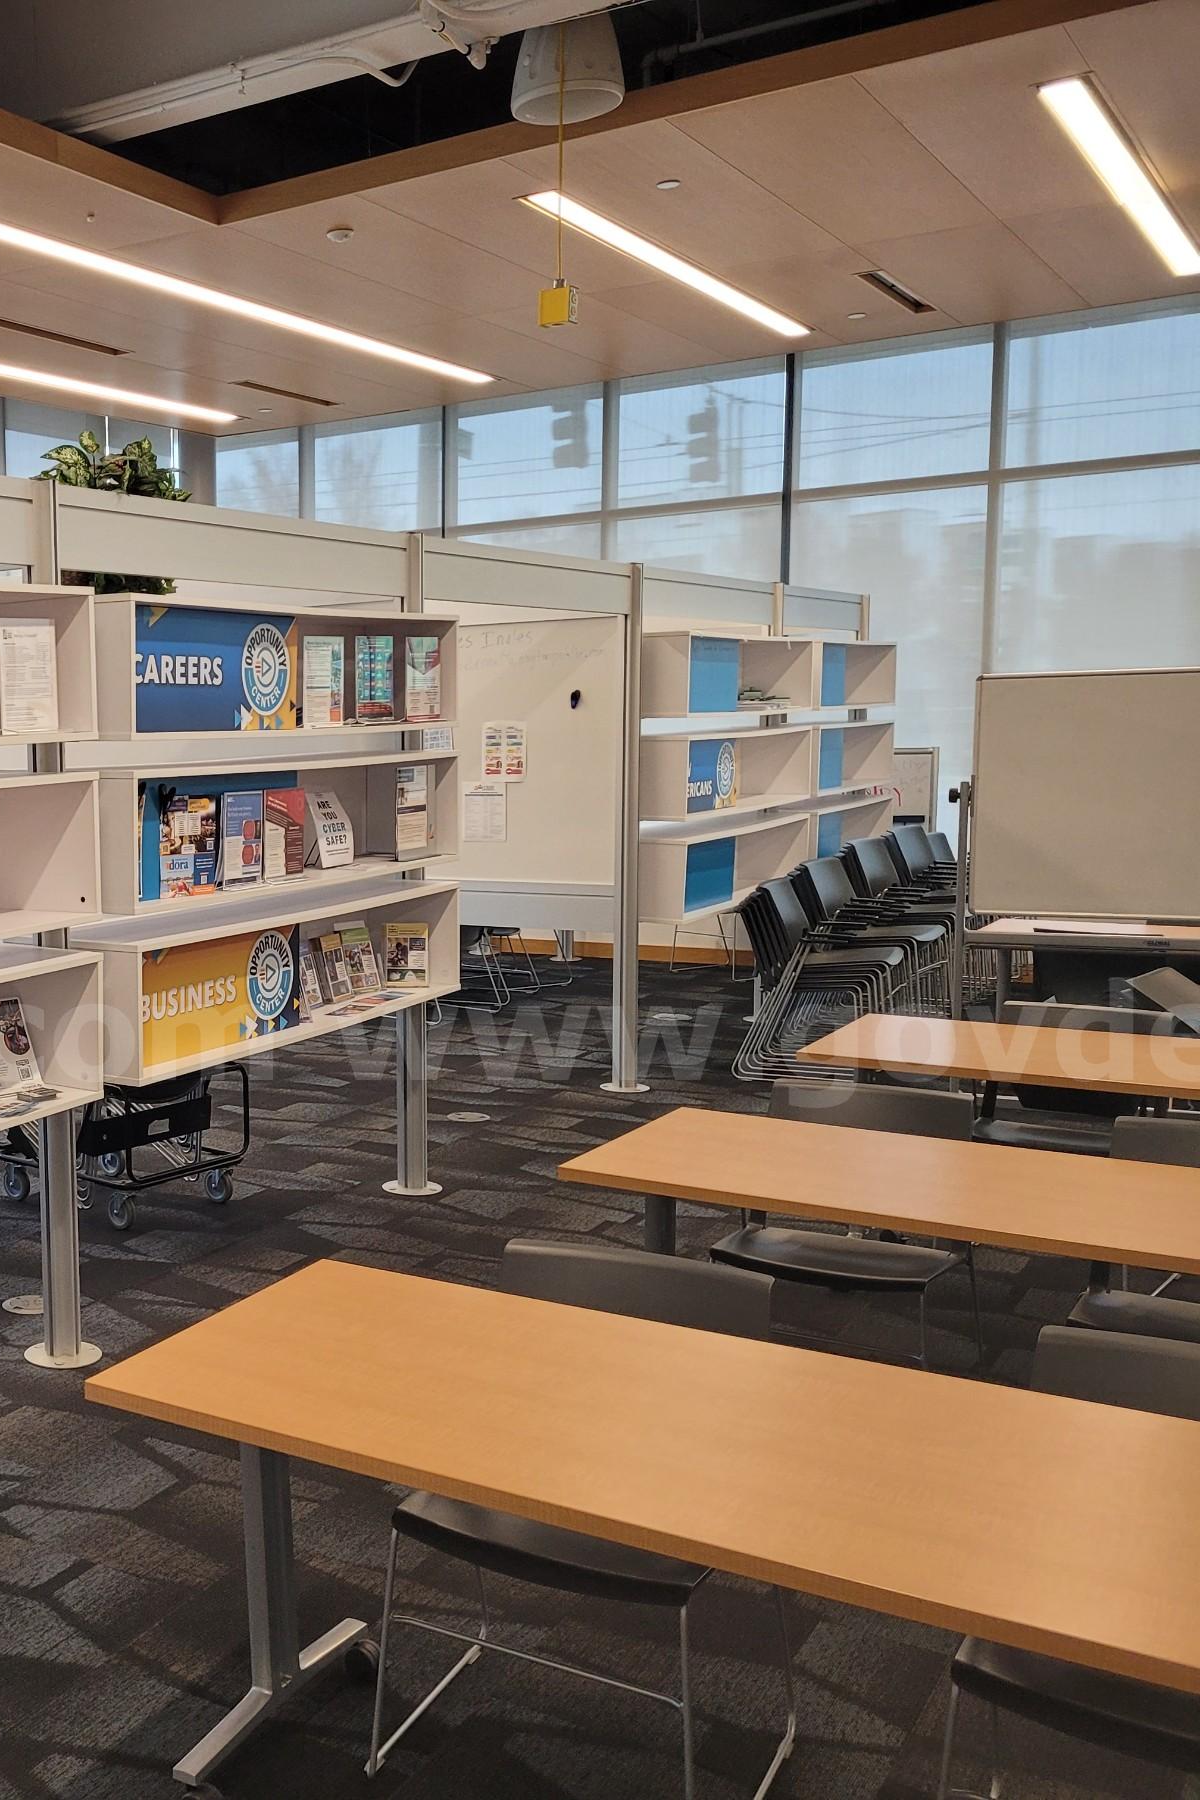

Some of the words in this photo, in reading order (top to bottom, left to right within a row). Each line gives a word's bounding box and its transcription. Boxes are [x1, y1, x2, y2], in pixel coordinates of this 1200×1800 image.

[244, 628, 287, 668] OPPORTUNITY
[135, 653, 224, 686] CAREERS
[251, 687, 282, 707] CENTER
[316, 800, 332, 810] ARE
[321, 811, 338, 821] YOU
[322, 822, 346, 834] CYBER
[325, 834, 348, 846] SAFE?
[249, 930, 291, 977] OPPORTUNITY
[141, 975, 238, 1023] BUSINESS
[255, 989, 286, 1009] CENTER
